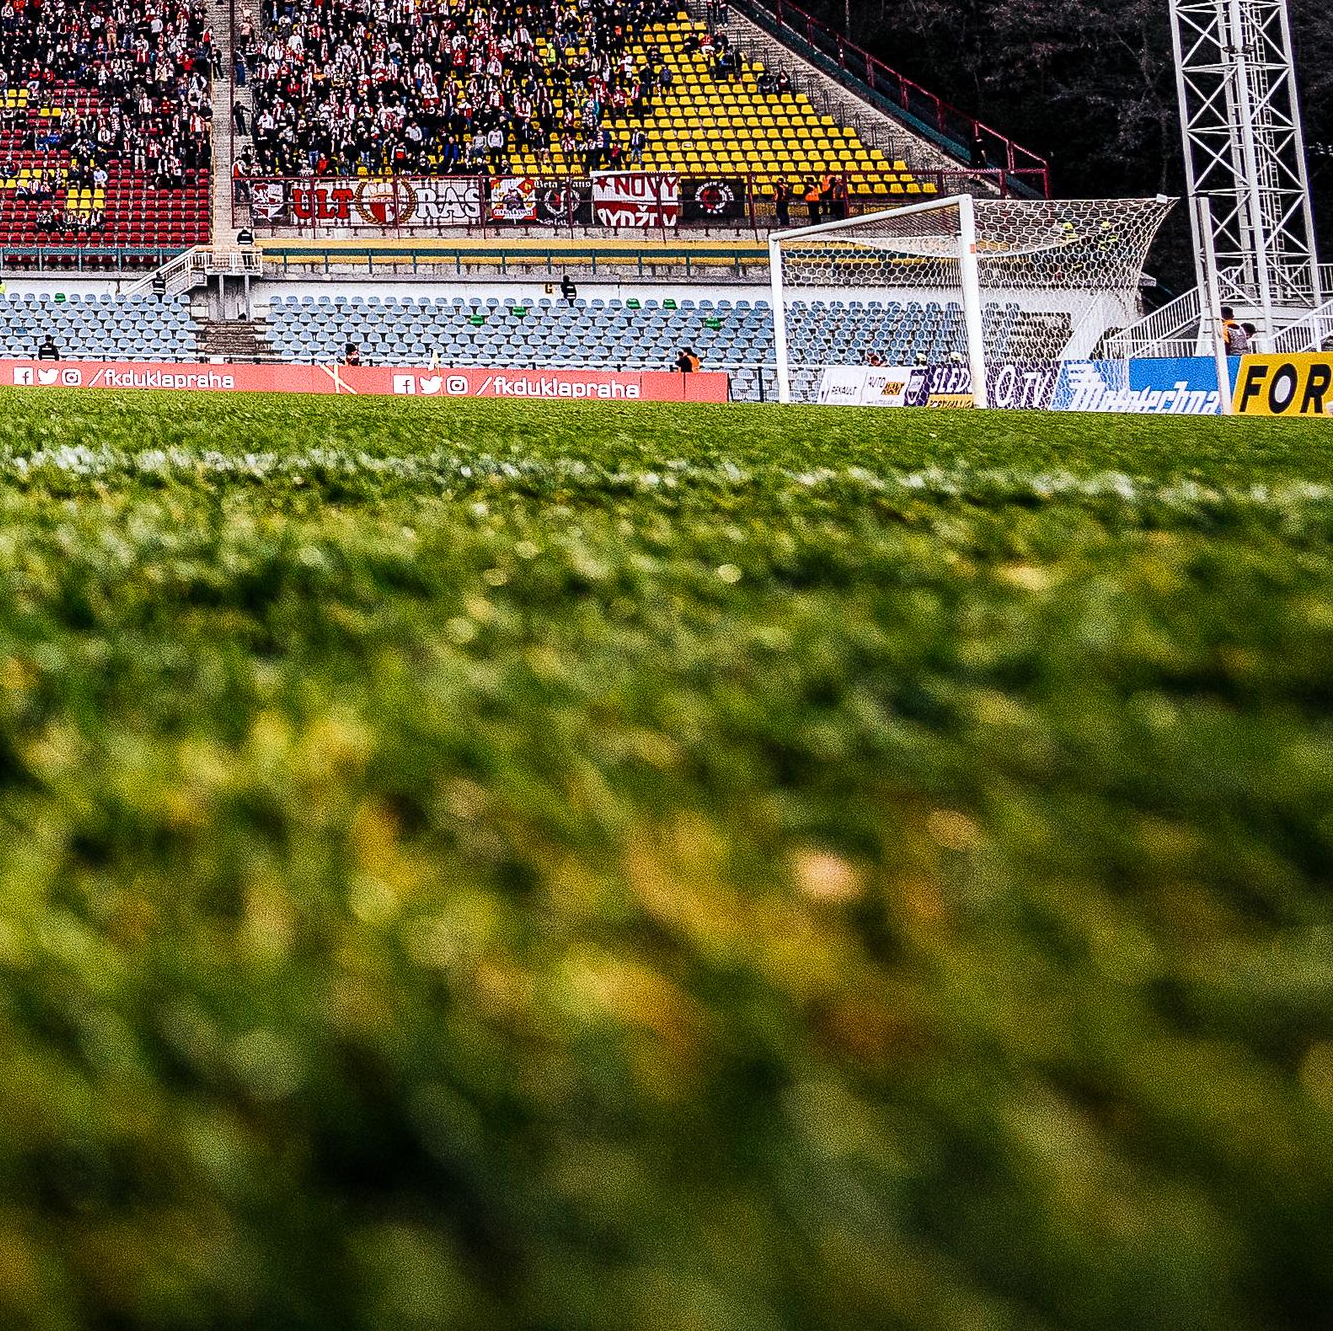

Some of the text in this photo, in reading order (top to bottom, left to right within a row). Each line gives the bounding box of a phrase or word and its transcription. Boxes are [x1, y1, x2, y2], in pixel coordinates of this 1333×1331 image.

[415, 186, 480, 219] RAS
[88, 369, 234, 389] /fkduklapraha
[476, 376, 641, 400] /fkduklapraha
[930, 368, 972, 393] SLED
